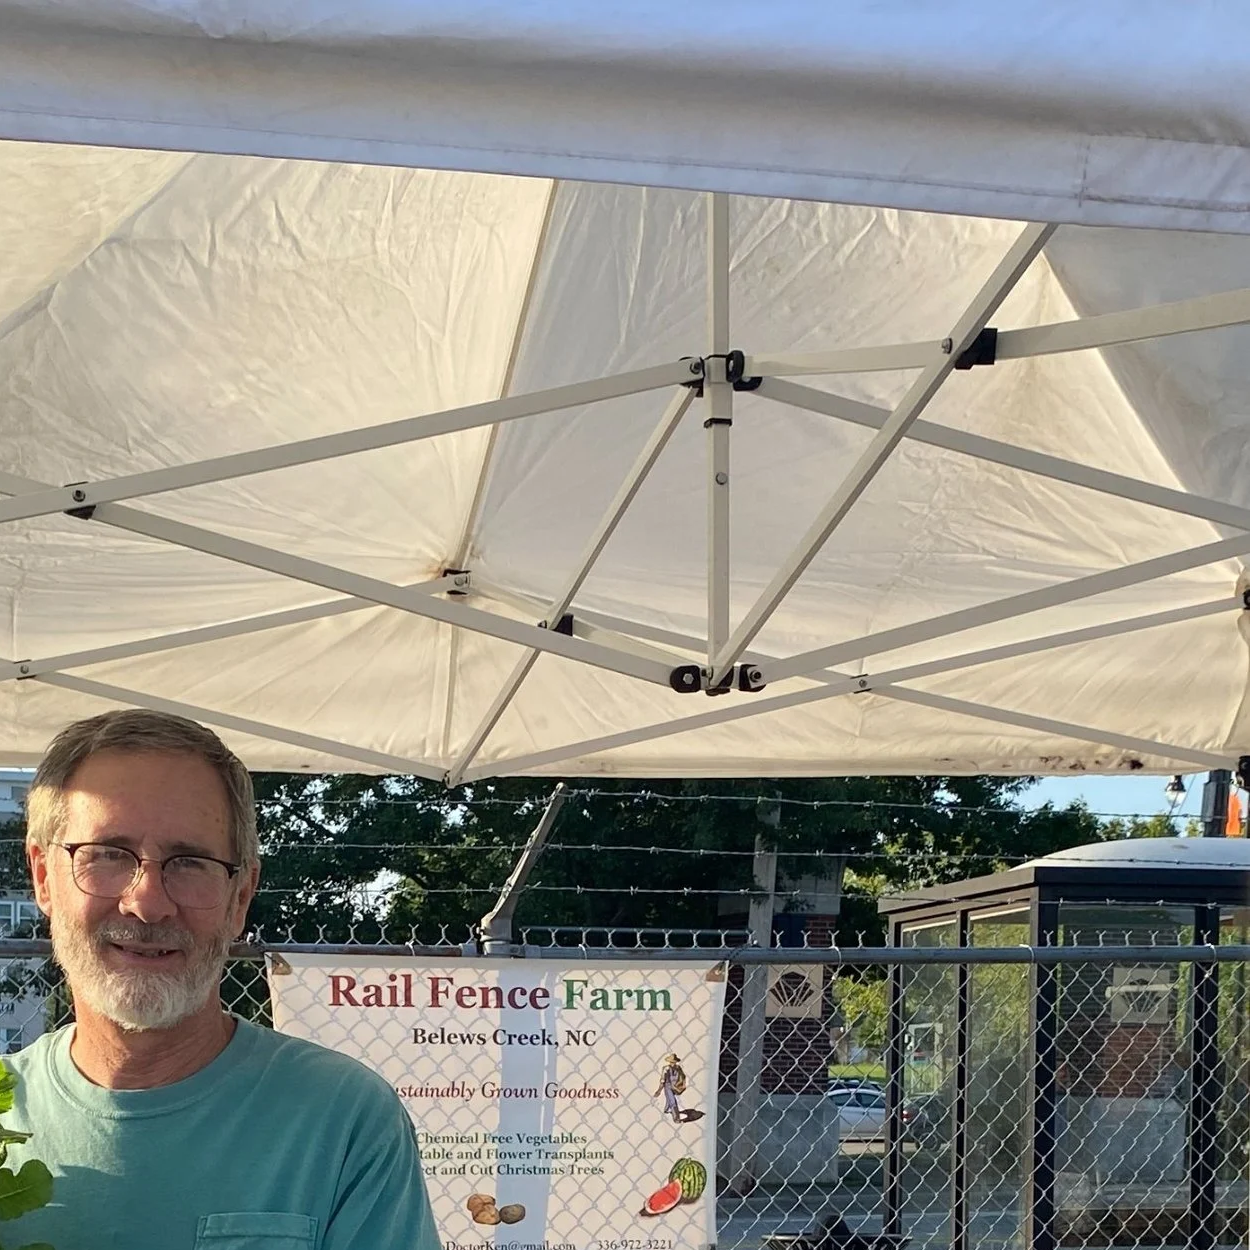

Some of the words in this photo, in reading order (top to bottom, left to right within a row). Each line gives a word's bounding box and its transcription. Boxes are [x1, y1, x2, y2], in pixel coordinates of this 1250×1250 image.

[328, 974, 415, 1008] Rail
[428, 976, 550, 1010] Fence
[562, 979, 673, 1012] Farm
[413, 1027, 487, 1046] Belews
[492, 1028, 559, 1049] Creek,
[565, 1030, 597, 1047] NC
[395, 1081, 475, 1102] stainably
[481, 1081, 538, 1099] Grown
[545, 1081, 620, 1099] Goodness
[417, 1132, 479, 1144] Chemical
[483, 1133, 513, 1144] Free
[516, 1132, 588, 1147] Vegetables
[420, 1148, 453, 1160] table
[456, 1148, 482, 1160] and
[486, 1148, 533, 1160] Flower
[535, 1147, 615, 1162] Transplants
[440, 1164, 466, 1176] and
[470, 1164, 494, 1176] Cut
[497, 1163, 565, 1176] Christmas
[568, 1164, 605, 1176] Trees
[597, 1239, 673, 1250] 336-972-3221
